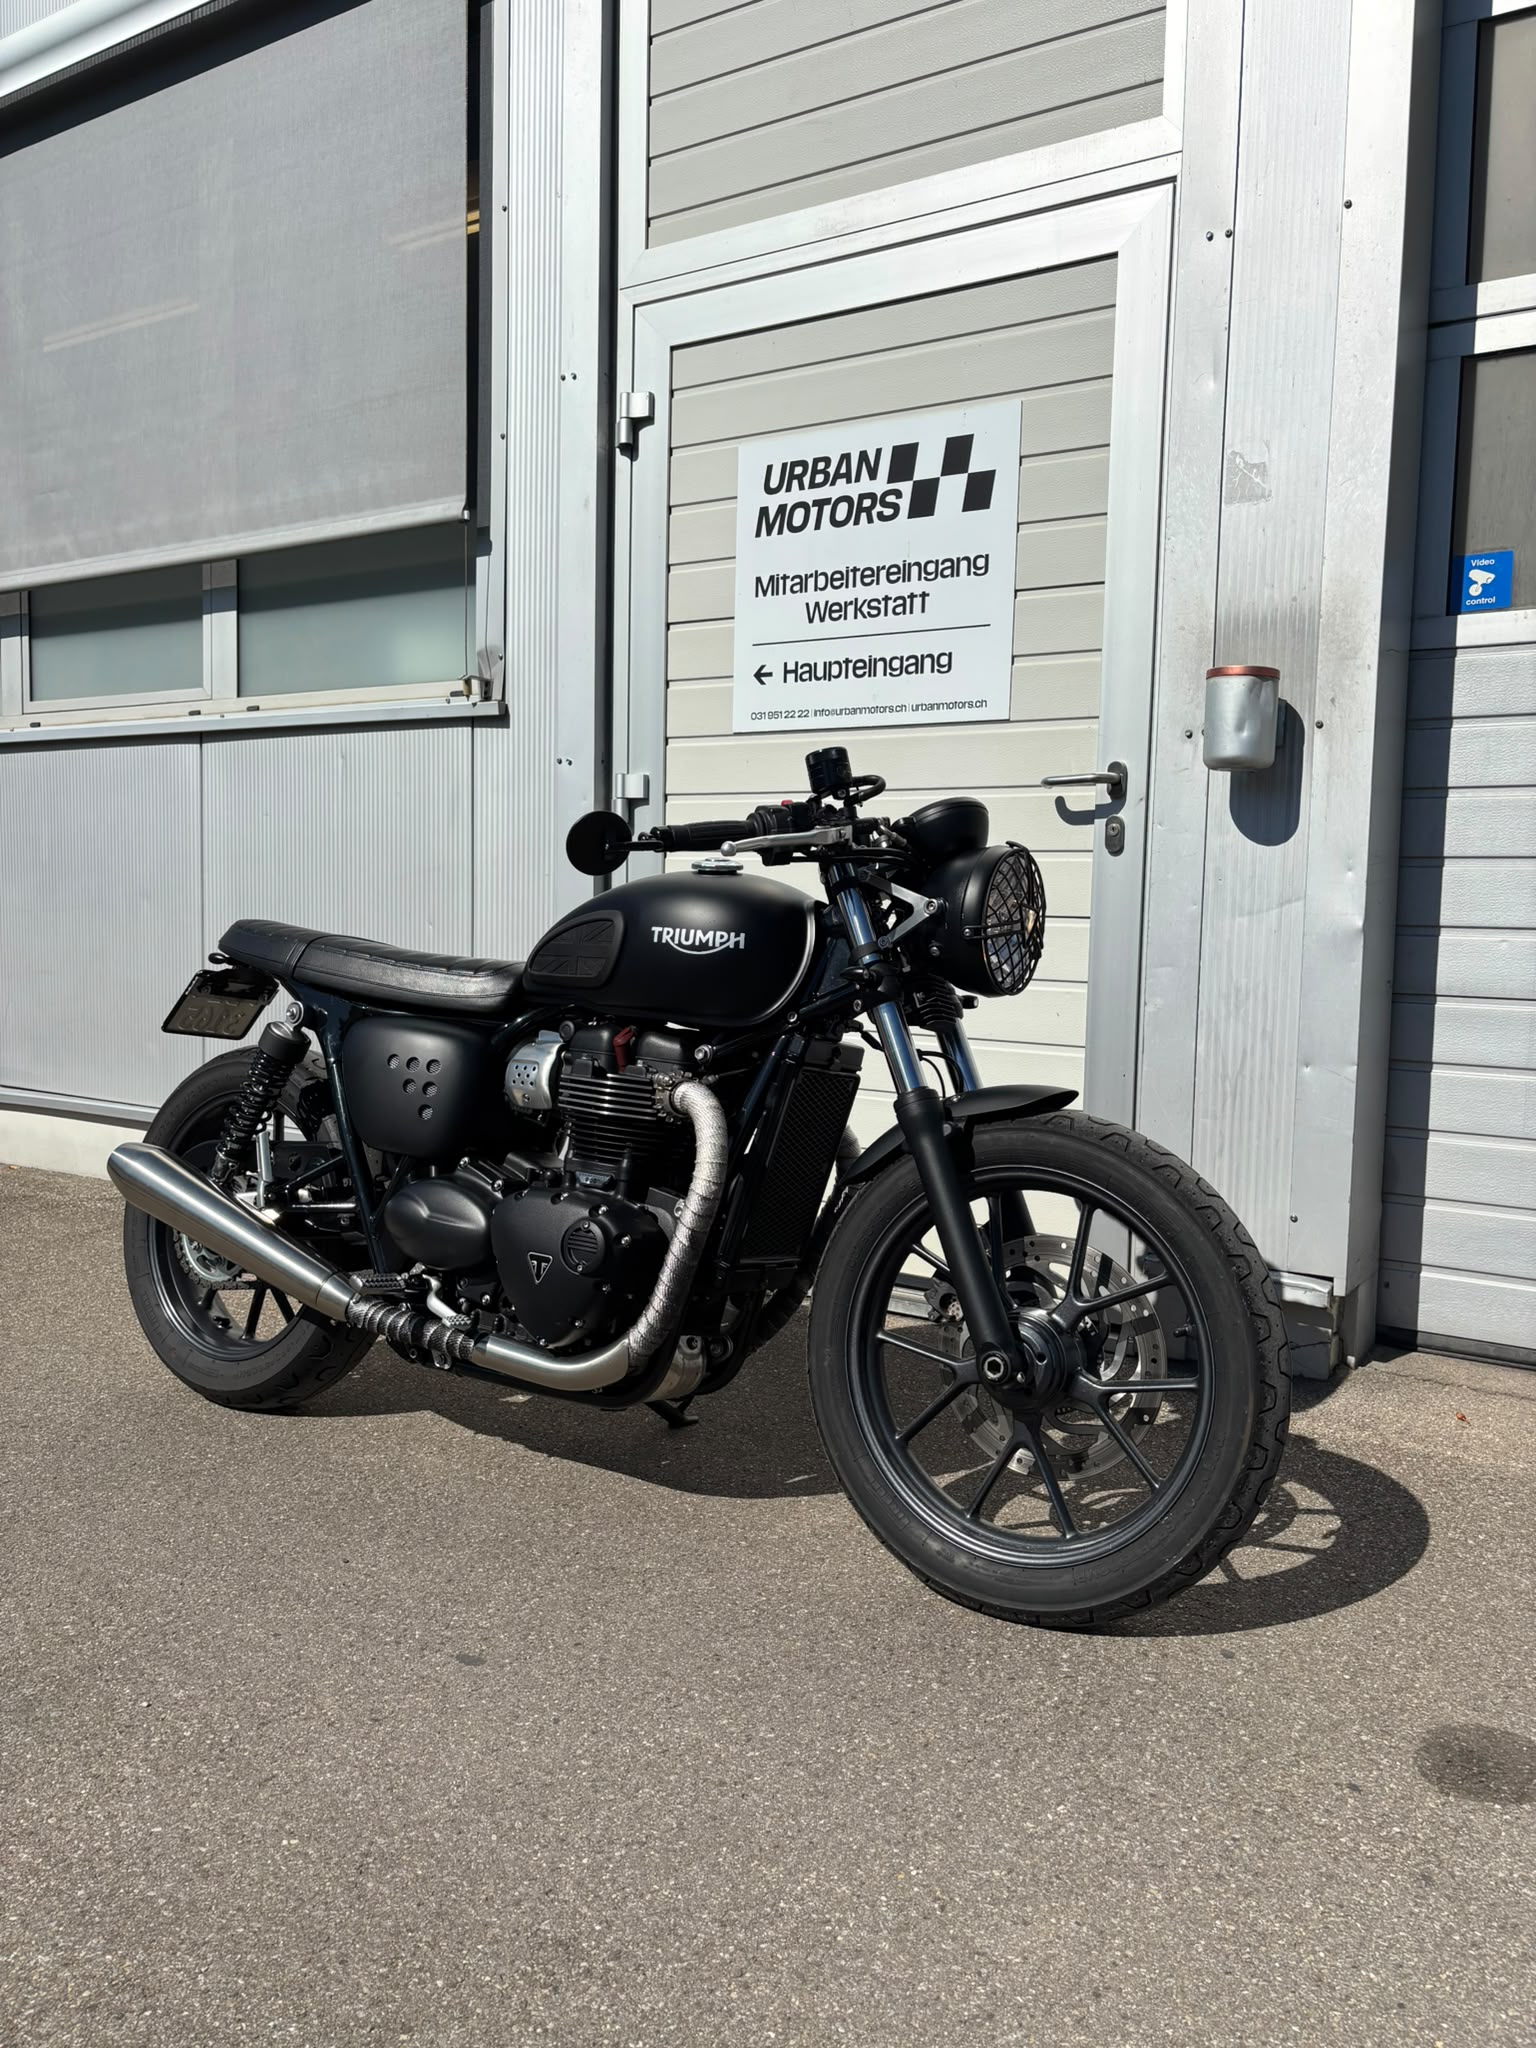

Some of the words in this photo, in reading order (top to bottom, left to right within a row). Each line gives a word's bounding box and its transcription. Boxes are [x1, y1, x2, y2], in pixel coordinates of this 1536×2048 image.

[763, 447, 883, 495] URBAN
[754, 488, 903, 538] MOTORS
[754, 553, 990, 598] Mitarbeitereingang
[1471, 558, 1495, 567] Video
[805, 590, 930, 624] Werkstatt
[1466, 596, 1496, 605] control
[783, 651, 953, 684] Haupteingang
[910, 699, 988, 713] urbanmotors.ch
[651, 926, 745, 954] TRIUMPH
